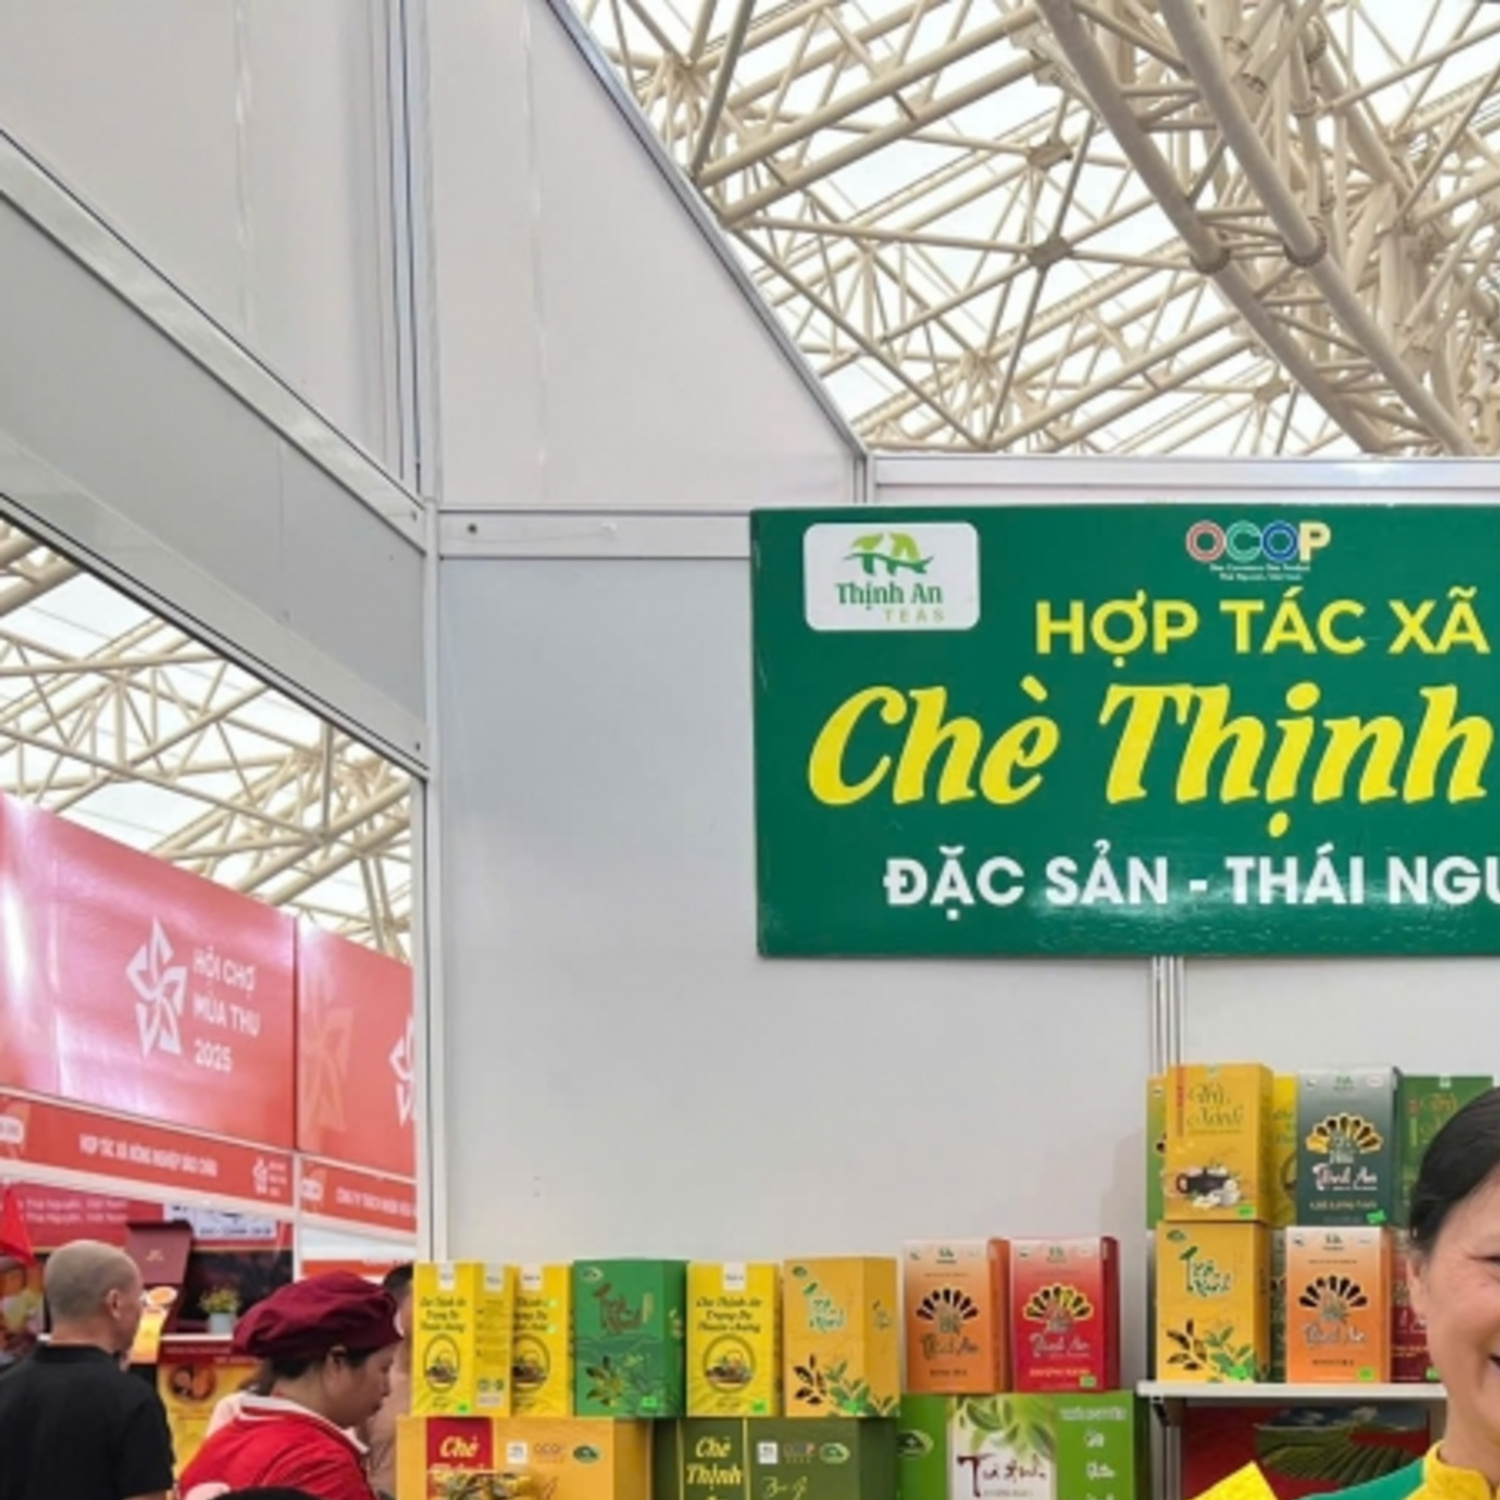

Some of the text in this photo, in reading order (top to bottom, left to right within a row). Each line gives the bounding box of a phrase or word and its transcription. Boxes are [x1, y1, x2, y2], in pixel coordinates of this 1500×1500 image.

[1186, 519, 1331, 563] OCOP
[836, 581, 943, 610] Thịnh An
[885, 609, 944, 623] TEAS
[1035, 586, 1491, 668] HỢP TÁC XÃ
[807, 675, 1062, 805] Chè
[1098, 681, 1495, 838] Thịnh
[883, 845, 1025, 921] ĐẶC
[1044, 839, 1169, 906] SẢN
[1188, 879, 1208, 892] -
[1224, 842, 1365, 906] THÁI
[193, 946, 257, 1001] HỘI CHỢ
[193, 986, 261, 1037] MÙA THU
[193, 1040, 234, 1073] 2025
